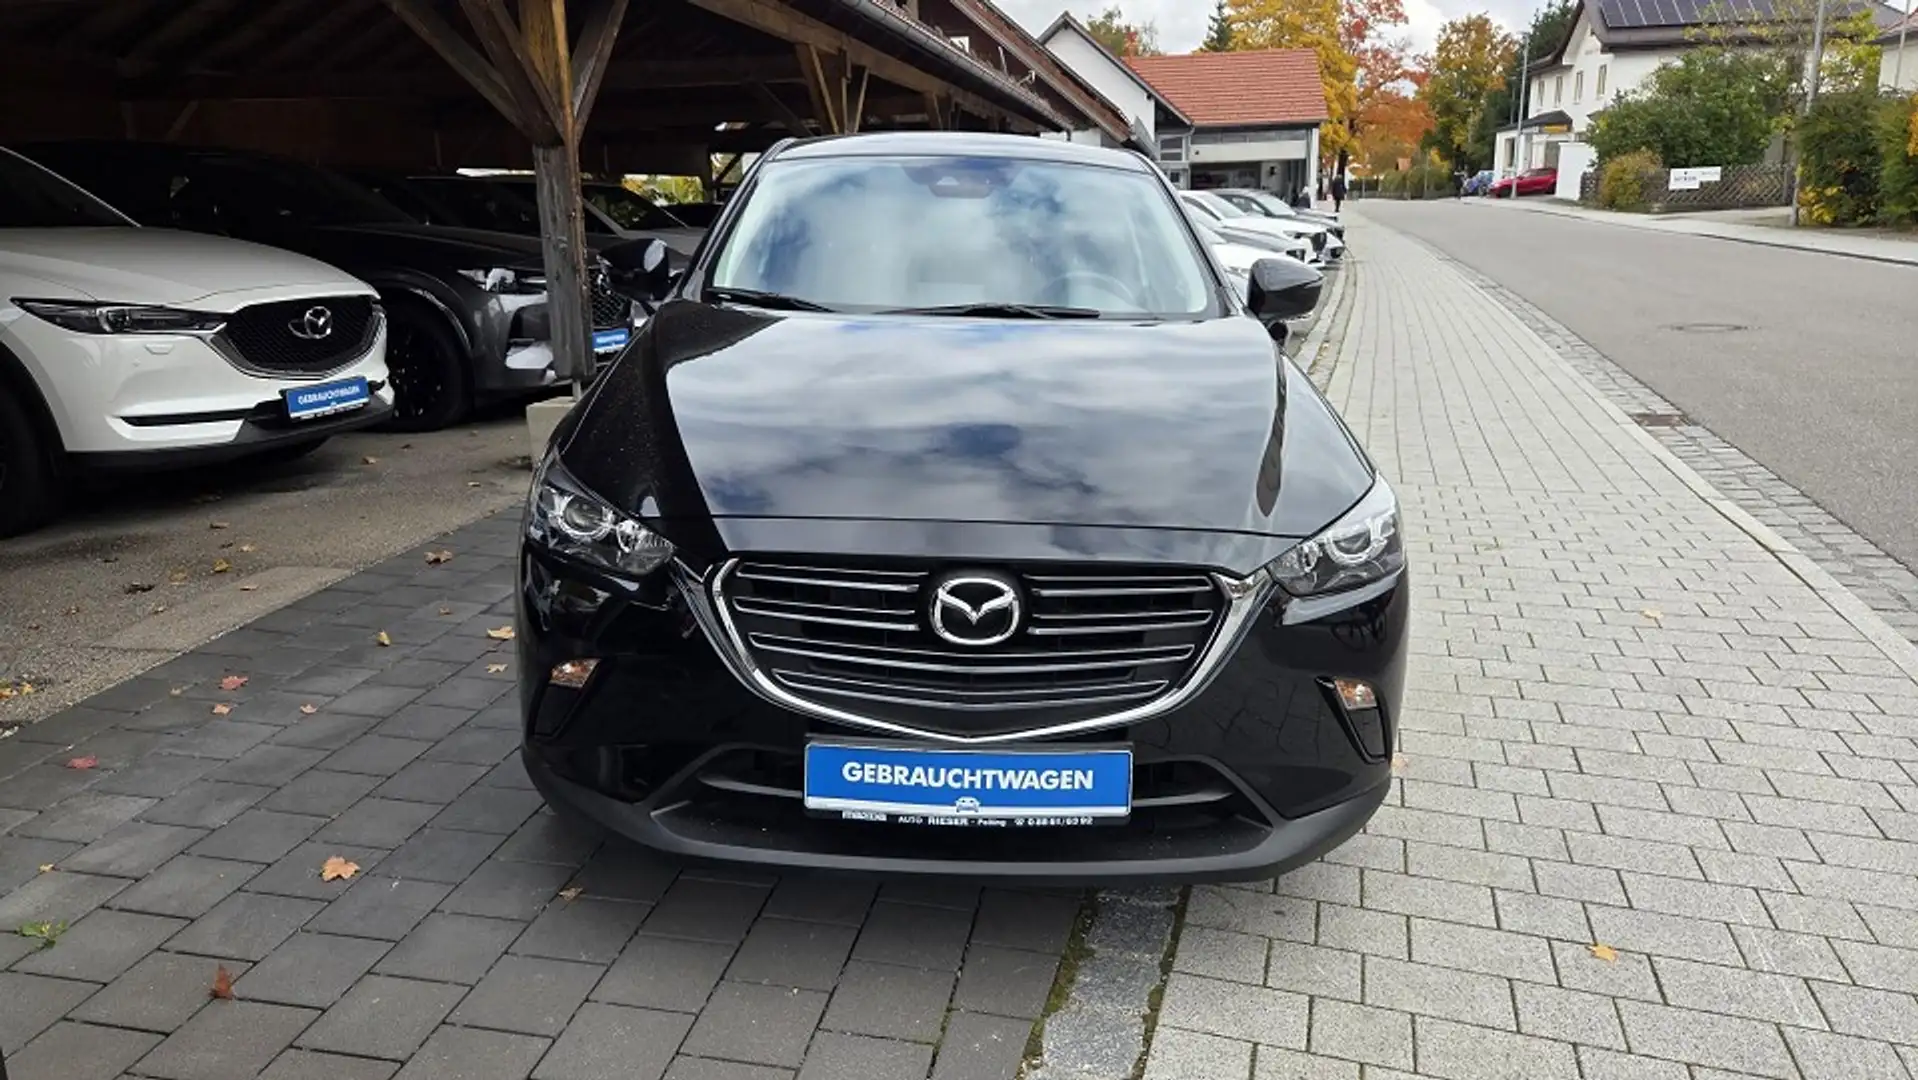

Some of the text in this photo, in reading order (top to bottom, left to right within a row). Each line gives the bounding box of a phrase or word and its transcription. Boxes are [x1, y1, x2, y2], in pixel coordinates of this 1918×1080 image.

[298, 386, 360, 404] GEBRAUCHTWAGEN
[842, 761, 1094, 790] GEBRAUCHTWAGEN
[928, 816, 969, 826] RIESER
